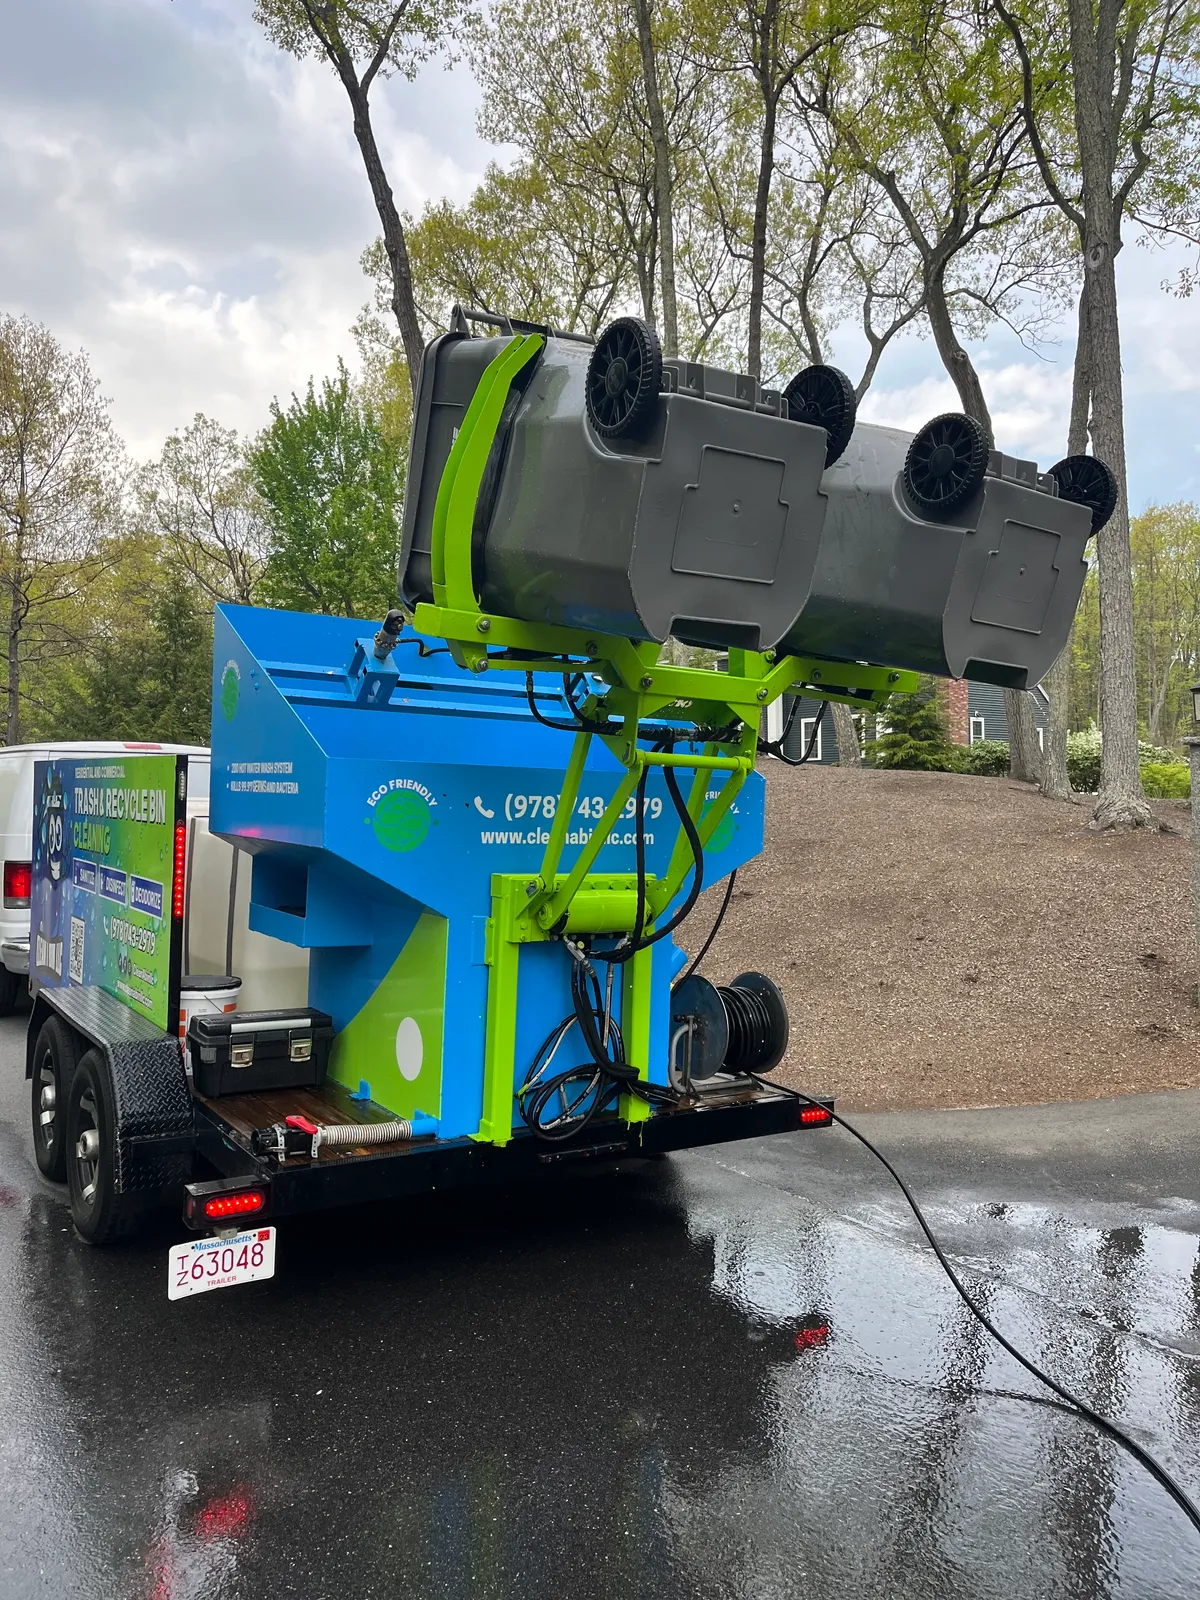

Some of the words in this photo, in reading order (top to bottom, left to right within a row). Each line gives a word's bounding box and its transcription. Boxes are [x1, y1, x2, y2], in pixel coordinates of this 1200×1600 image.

[247, 763, 261, 773] WATER
[261, 762, 273, 773] WASH
[274, 762, 292, 773] SYSTEM
[276, 782, 299, 794] BACTERIA
[367, 784, 388, 807] ECO
[388, 778, 438, 807] FRIENDLY
[74, 787, 99, 815] TRASH
[100, 788, 105, 816] &
[106, 788, 148, 823] RECYCLE
[149, 789, 166, 824] BIN
[705, 791, 740, 814] FRILY
[73, 822, 111, 855] CLEANING
[105, 876, 127, 896] DISINFECT
[135, 886, 161, 910] DEODORIZE
[193, 1235, 252, 1252] Massachusetts
[259, 1233, 269, 1241] 23
[191, 1242, 264, 1280] 63048
[207, 1275, 237, 1287] TRAILER
